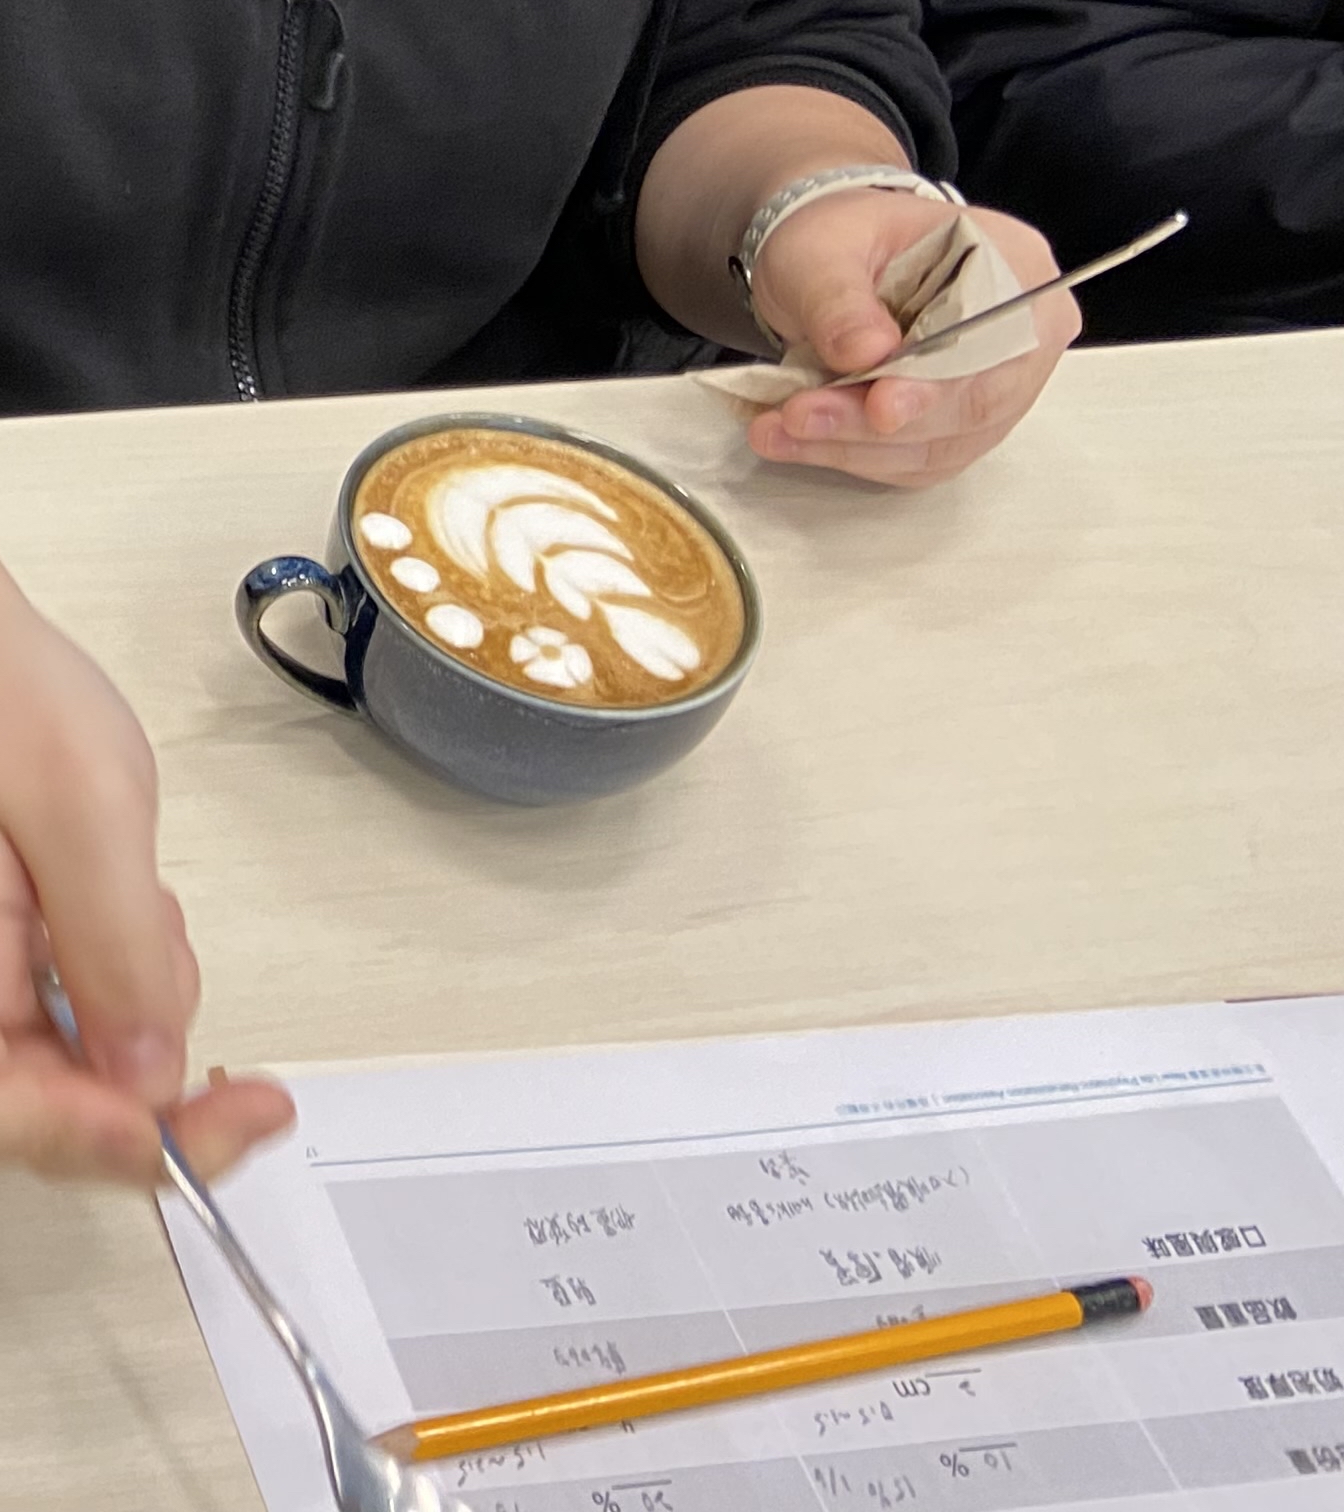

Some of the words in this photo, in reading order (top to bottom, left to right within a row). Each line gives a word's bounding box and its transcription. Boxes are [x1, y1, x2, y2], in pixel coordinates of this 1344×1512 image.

[1142, 1225, 1266, 1260] 口感與風味
[1194, 1297, 1296, 1330] 飲品重量
[892, 1377, 930, 1400] cm
[1238, 1368, 1343, 1400] 奶泡厚度
[939, 1453, 969, 1477] %
